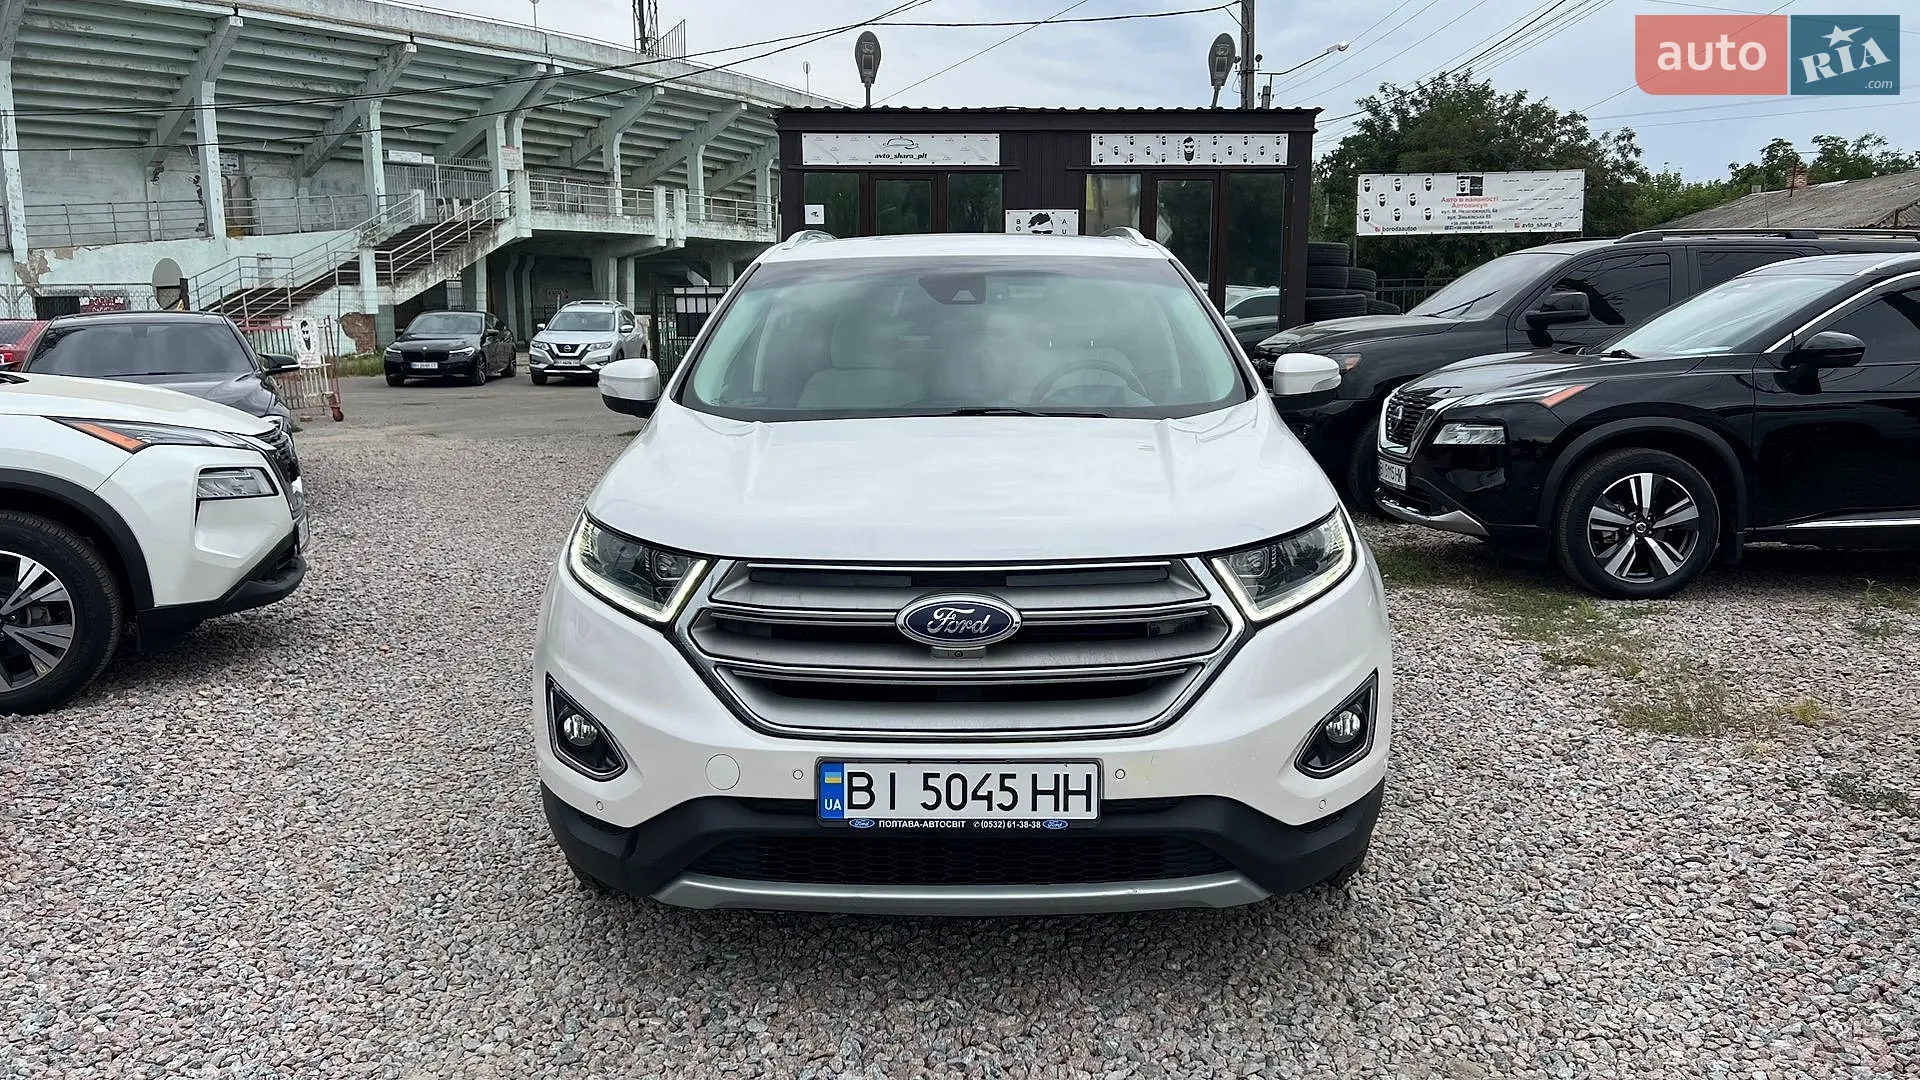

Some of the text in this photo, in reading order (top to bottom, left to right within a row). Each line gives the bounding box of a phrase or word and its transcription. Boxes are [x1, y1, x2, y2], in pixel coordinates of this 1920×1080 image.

[927, 607, 991, 634] Ford
[847, 771, 1092, 812] BI 5045 HH
[824, 799, 842, 810] UA
[879, 819, 1041, 829] ПОЛТАВА-АВТОСВІТ (0532) 61-38-38
